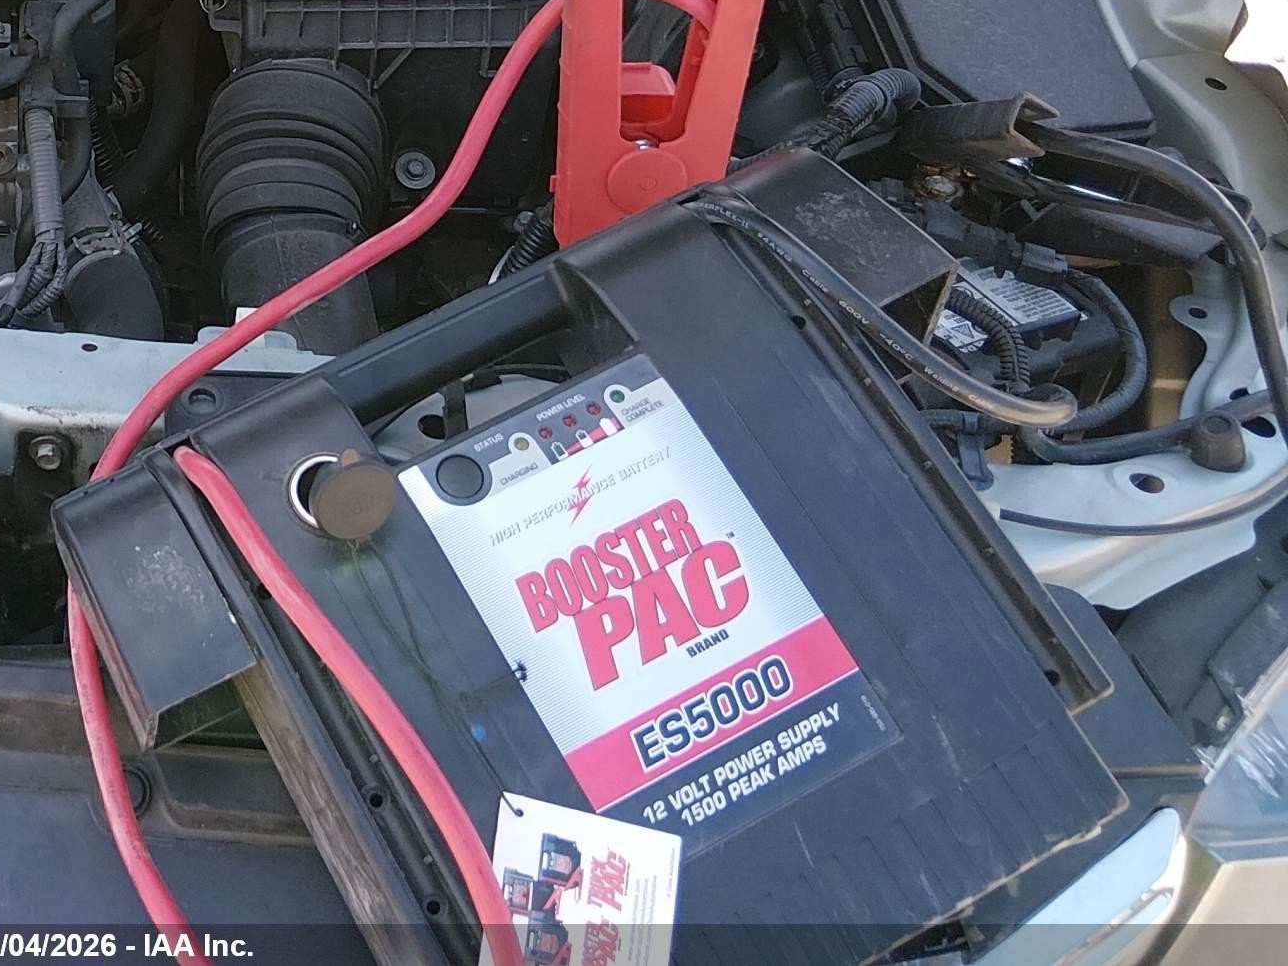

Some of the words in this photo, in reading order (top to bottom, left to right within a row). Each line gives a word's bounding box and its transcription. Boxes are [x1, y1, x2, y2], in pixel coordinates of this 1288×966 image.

[838, 300, 871, 325] 600V
[923, 366, 960, 393] Welding
[473, 432, 504, 453] STATUS
[536, 402, 565, 422] POWER
[563, 393, 587, 411] LEVEL
[620, 397, 652, 416] CHARGE
[625, 401, 665, 424] COMPLETE
[489, 519, 522, 547] HIGH
[524, 474, 617, 529] PERFORMANCE
[618, 444, 672, 483] BATTERY
[499, 462, 539, 487] CHARGING
[515, 498, 703, 634] BOOSTER
[574, 540, 750, 692] PAC
[685, 628, 730, 659] BRAND
[630, 654, 793, 774] ES5000
[643, 800, 668, 824] 12
[667, 775, 711, 812] VOLT
[713, 739, 778, 786] POWER
[777, 702, 841, 750] SUPPLY
[680, 795, 728, 827] 1500
[728, 767, 776, 802] PEAK
[777, 735, 827, 776] AMPS
